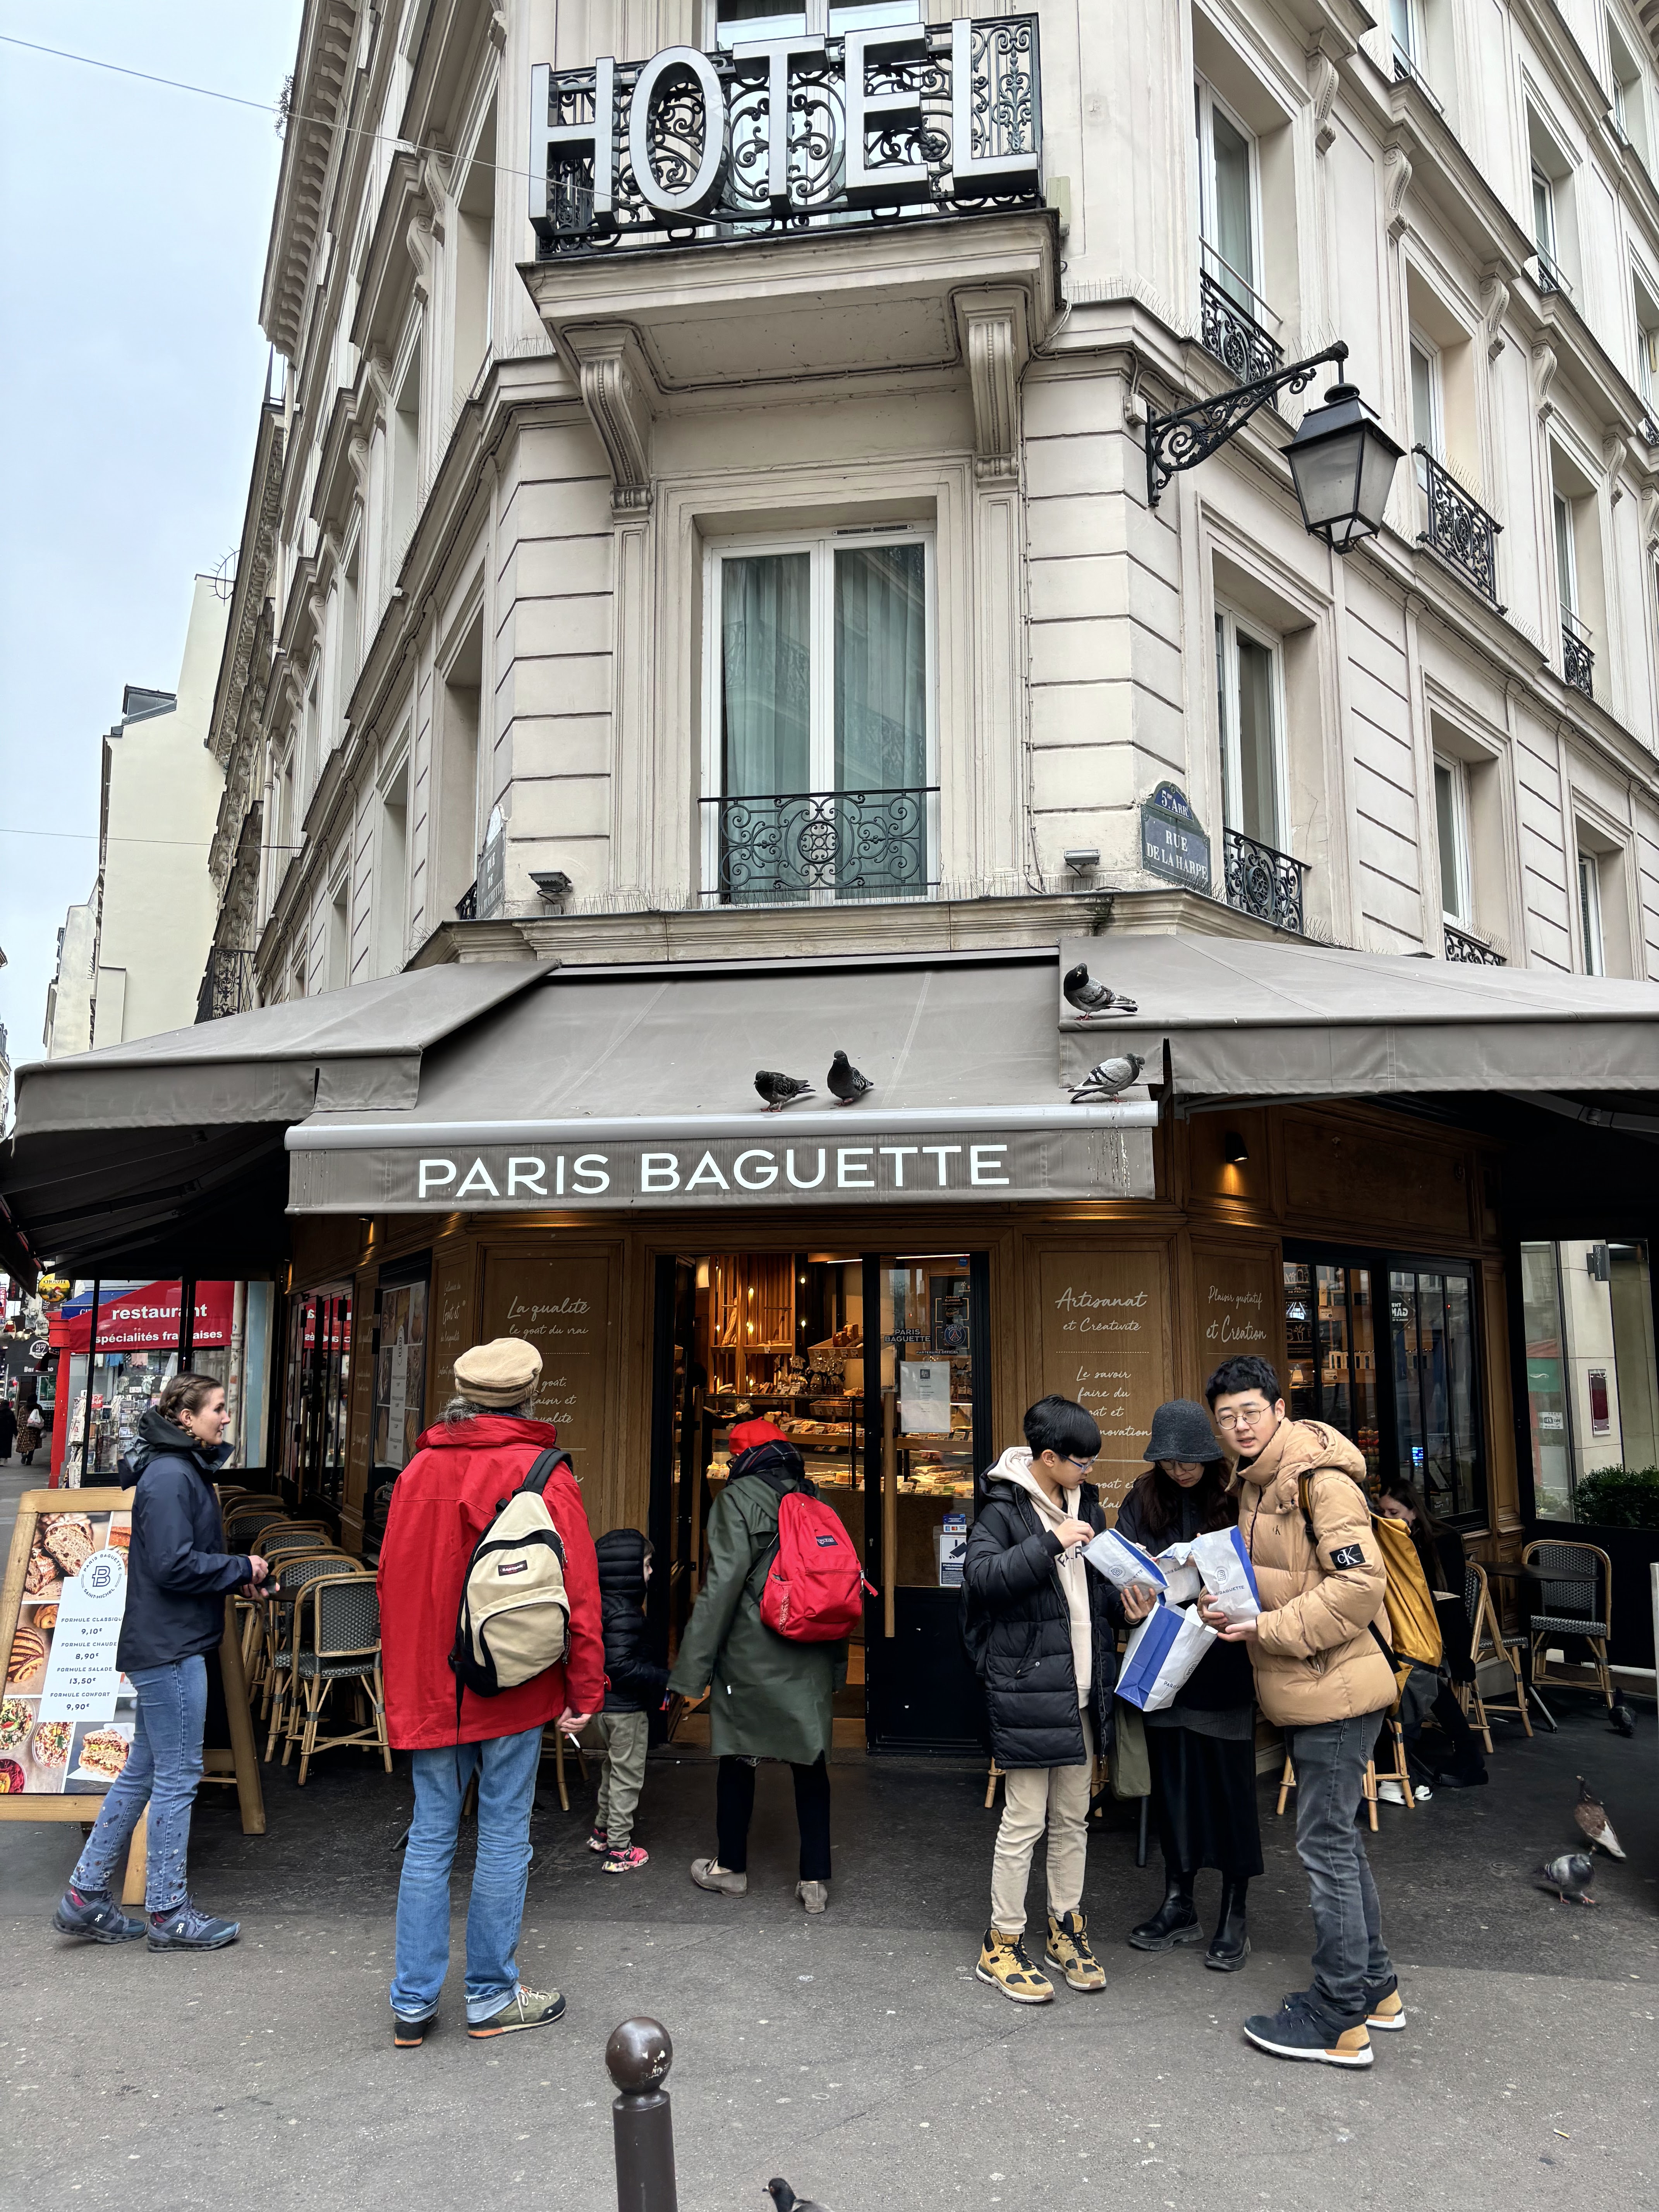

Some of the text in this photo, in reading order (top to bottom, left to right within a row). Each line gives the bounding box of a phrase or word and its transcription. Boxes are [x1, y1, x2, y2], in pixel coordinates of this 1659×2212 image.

[529, 18, 1039, 223] HOTEL
[1165, 830, 1188, 852] RUE
[1146, 842, 1207, 880] DE LA HARPE
[419, 1144, 1010, 1198] PARIS BAGUETTE
[1055, 1286, 1148, 1312] Artisanat
[1208, 1285, 1263, 1310] Plaisir gustatif
[507, 1296, 530, 1319] La
[509, 1324, 521, 1334] le
[549, 1324, 564, 1334] du
[1063, 1320, 1077, 1331] et
[1206, 1314, 1267, 1343] et Création
[95, 1331, 223, 1345] spécialités fraaises
[1076, 1365, 1132, 1381] Le savoir
[565, 1395, 577, 1405] et
[1077, 1387, 1131, 1403] faire du
[534, 1412, 574, 1423] ualité
[1110, 1406, 1125, 1417] et
[1099, 1425, 1152, 1436] novation
[100, 1554, 122, 1571] BAGUETTE
